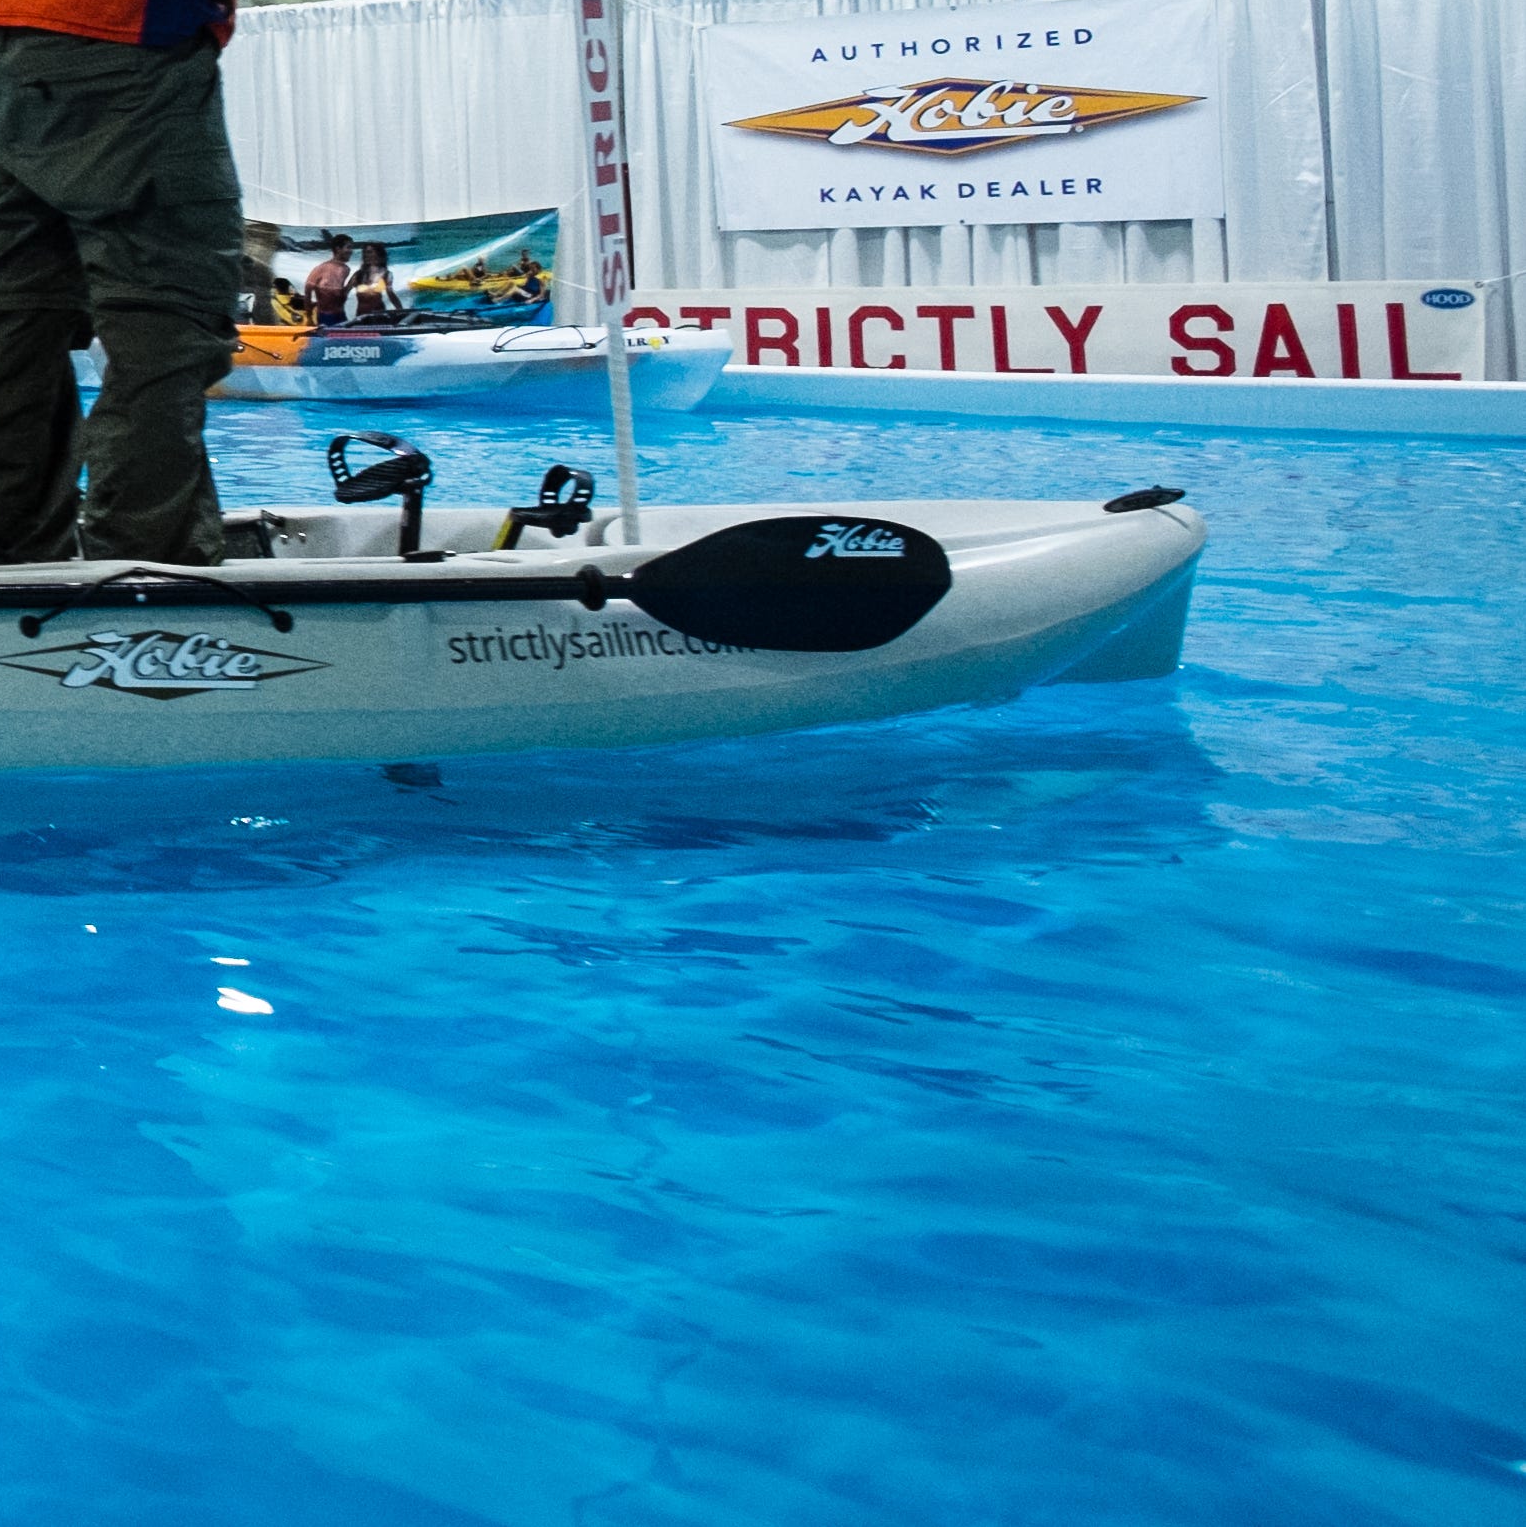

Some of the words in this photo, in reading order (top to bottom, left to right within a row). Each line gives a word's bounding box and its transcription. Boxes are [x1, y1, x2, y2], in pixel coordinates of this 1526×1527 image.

[811, 27, 1095, 64] AUTHORIZED
[827, 79, 1078, 146] Hobie
[818, 183, 938, 204] KAYAK
[957, 177, 1104, 199] DEALER
[1425, 293, 1472, 305] HOOD
[322, 345, 381, 360] jackson
[1168, 302, 1463, 381] SAIL
[804, 523, 906, 559] Hobie
[59, 630, 263, 689] Hobie
